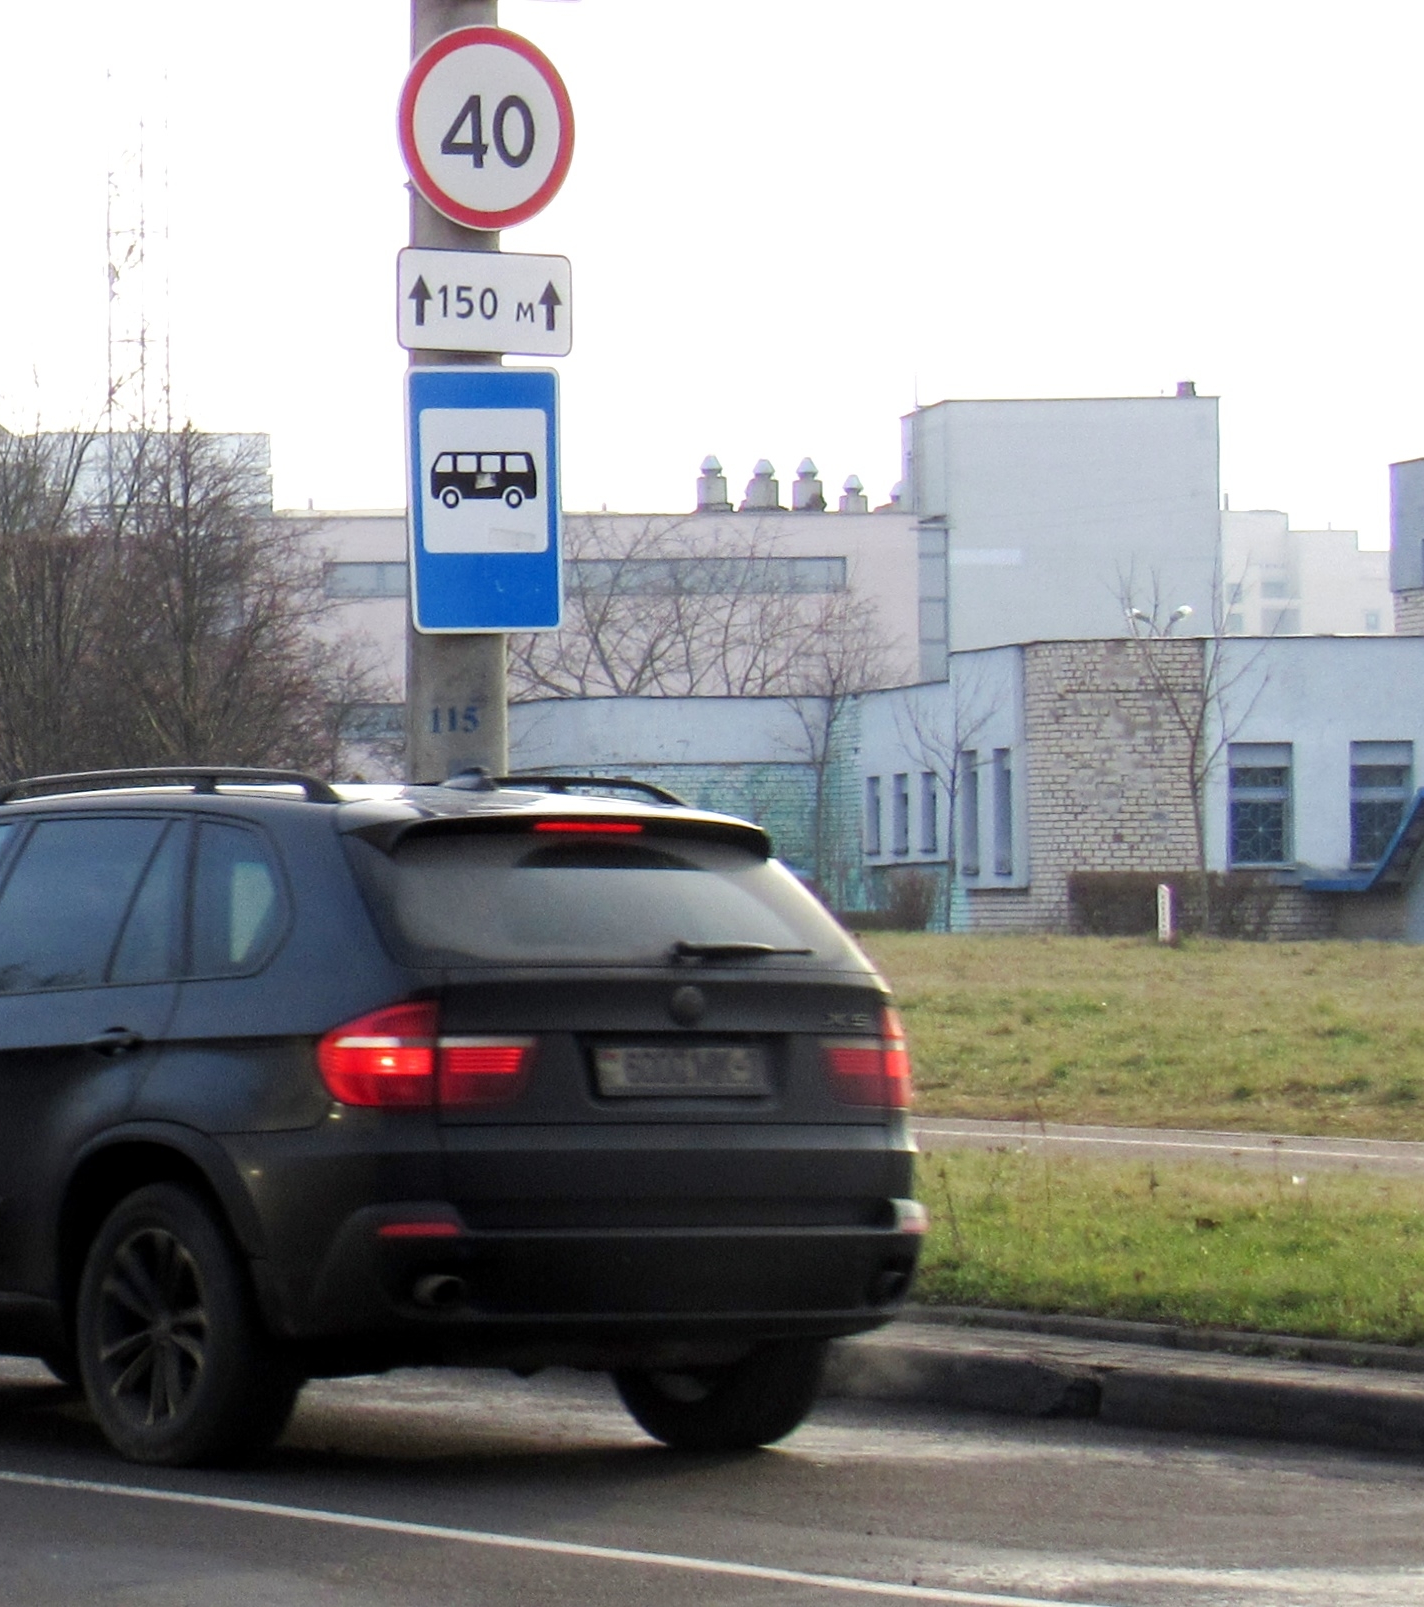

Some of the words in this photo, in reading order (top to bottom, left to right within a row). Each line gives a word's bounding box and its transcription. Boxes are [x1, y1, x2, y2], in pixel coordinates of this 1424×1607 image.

[441, 95, 535, 168] 40
[438, 285, 498, 320] 150
[430, 706, 480, 733] 115
